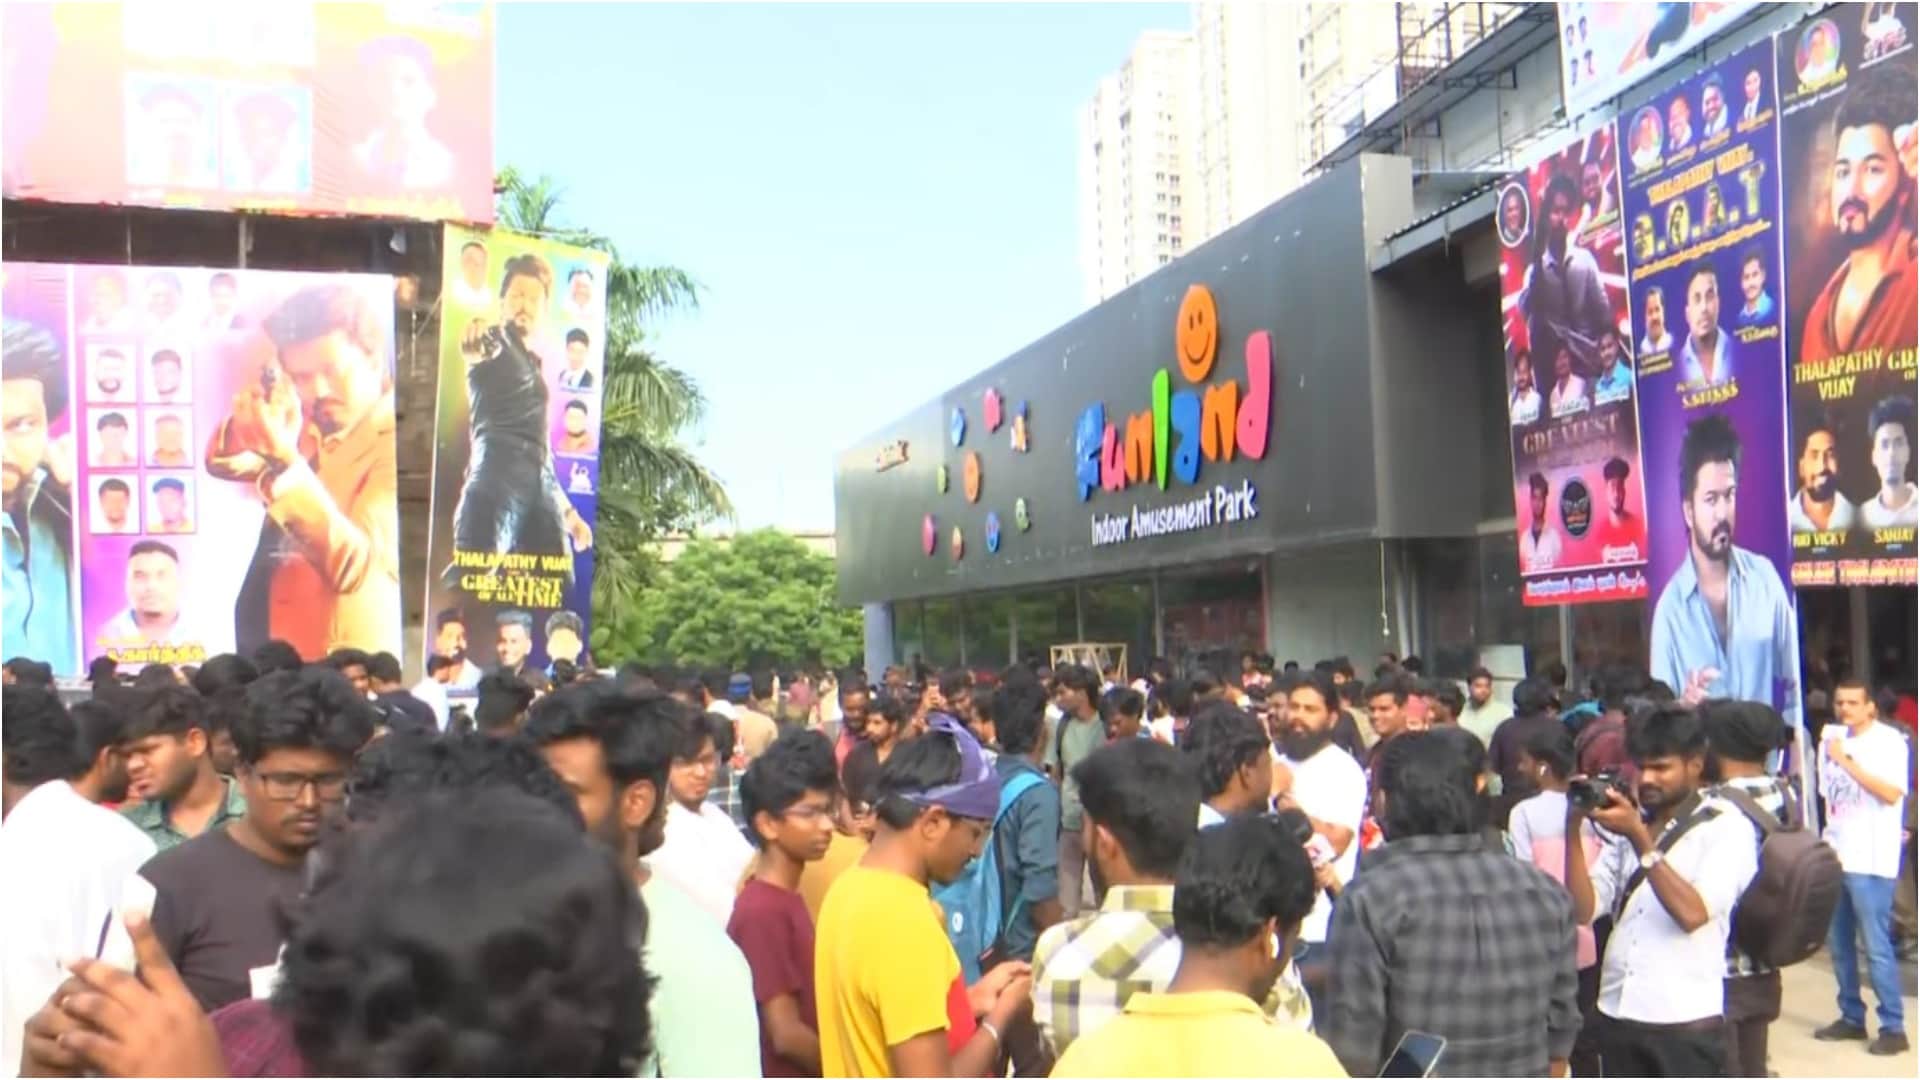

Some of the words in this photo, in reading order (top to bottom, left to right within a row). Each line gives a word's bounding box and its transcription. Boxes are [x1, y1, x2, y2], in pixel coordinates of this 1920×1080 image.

[1794, 347, 1883, 384] THALAPATHY
[1818, 375, 1856, 402] VIJAY
[1091, 513, 1129, 546] Indoor
[1130, 491, 1212, 538] Amusement
[1215, 478, 1257, 523] Park
[453, 551, 538, 569] THALAPATHY
[461, 574, 562, 595] GREATEST
